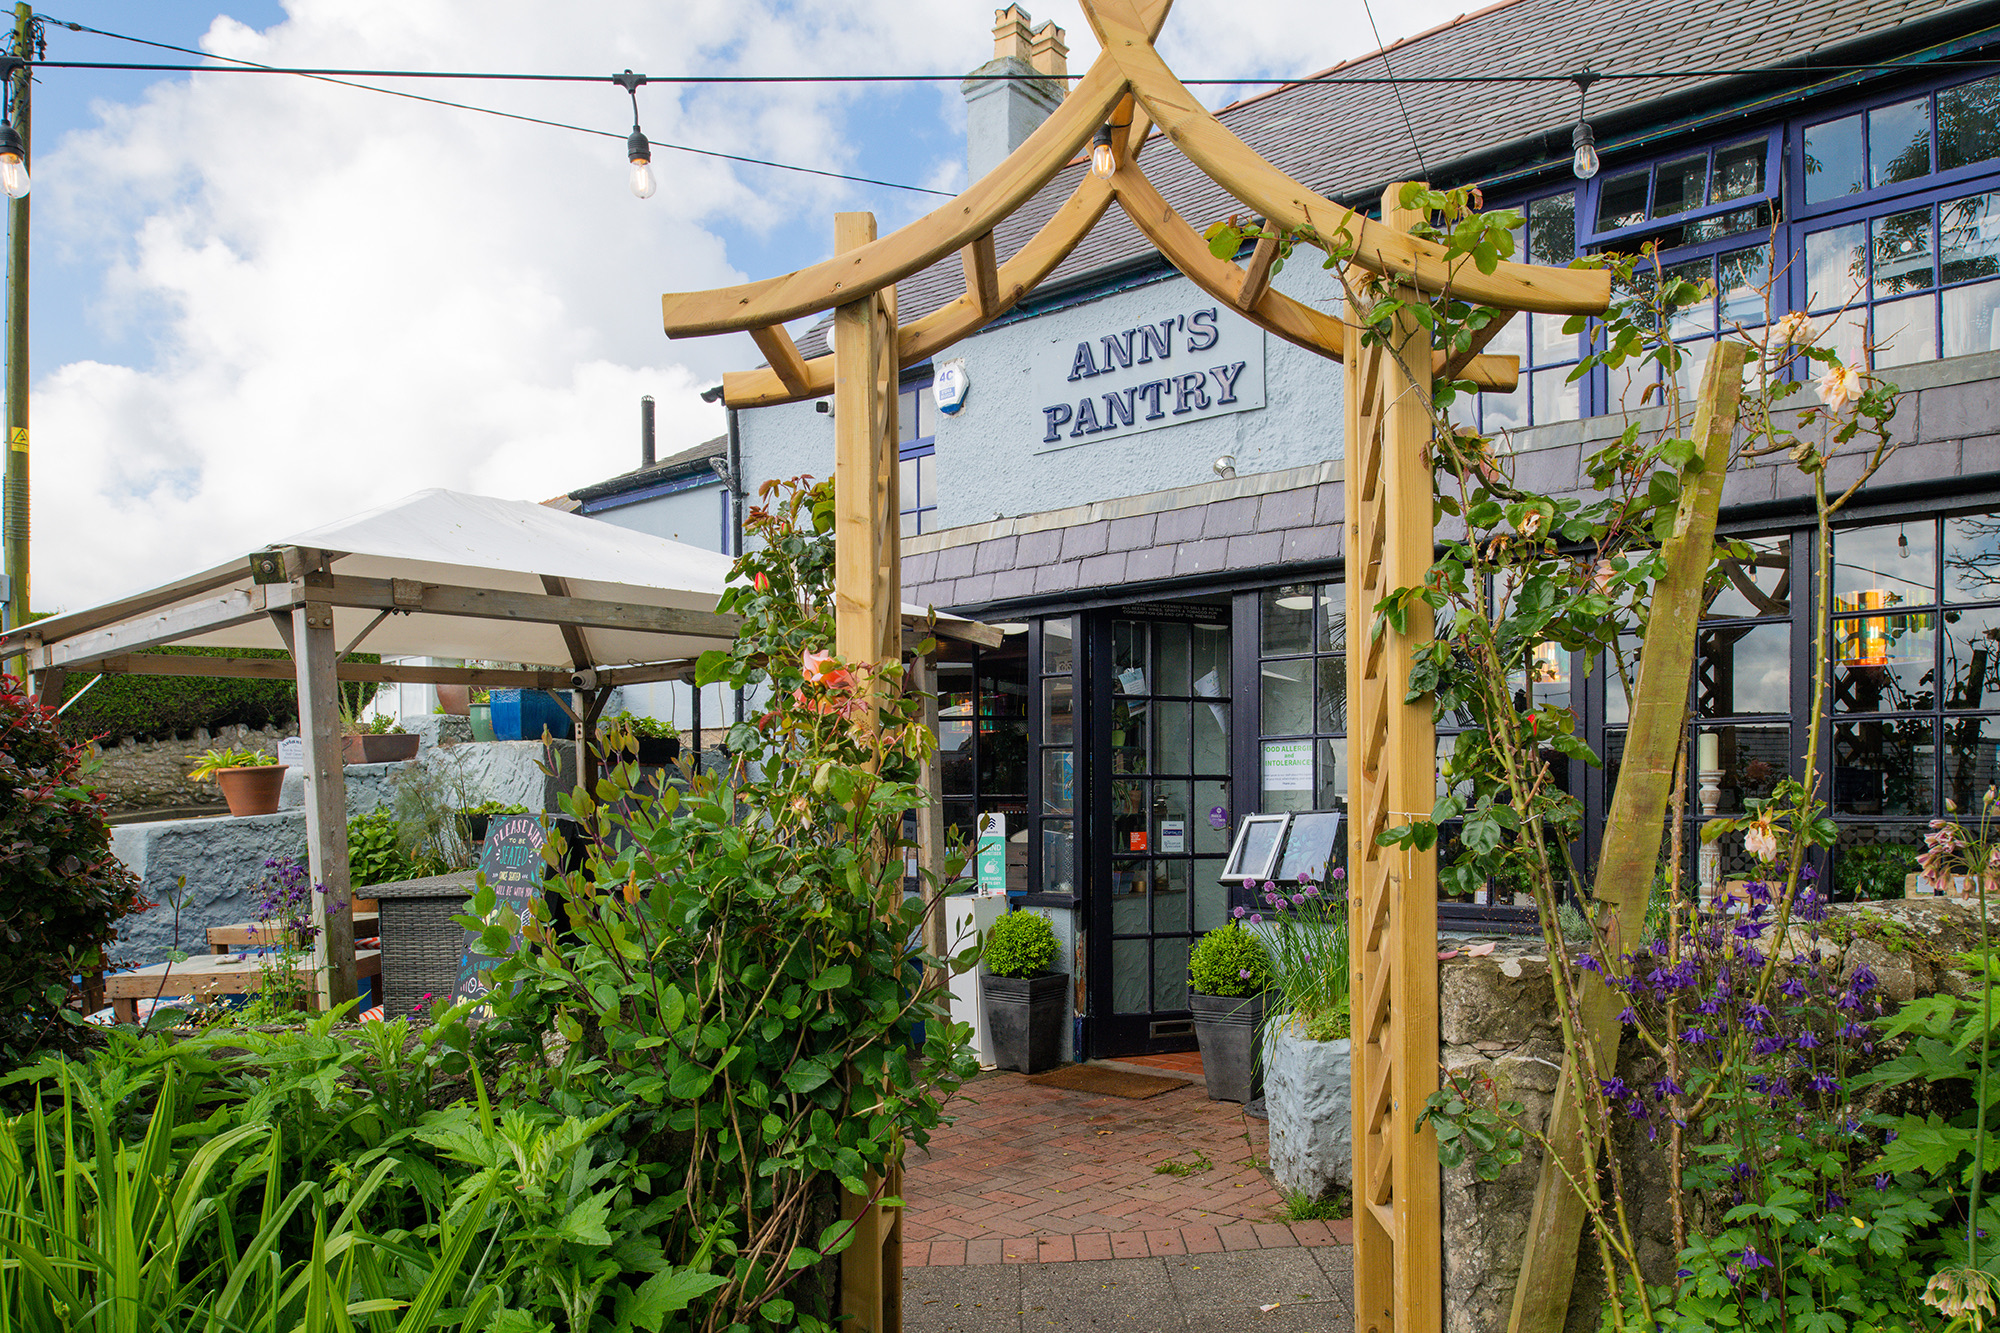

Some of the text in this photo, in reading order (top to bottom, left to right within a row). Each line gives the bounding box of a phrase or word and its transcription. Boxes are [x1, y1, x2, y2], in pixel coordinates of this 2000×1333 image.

[1066, 307, 1219, 382] ANN'S
[939, 370, 954, 382] 4C
[1042, 361, 1246, 443] PANTRY
[1281, 744, 1313, 753] ALLERGIE
[493, 819, 529, 847] PLEASE
[517, 837, 526, 845] BE
[981, 843, 1002, 851] HAND
[500, 845, 529, 867] SEATED
